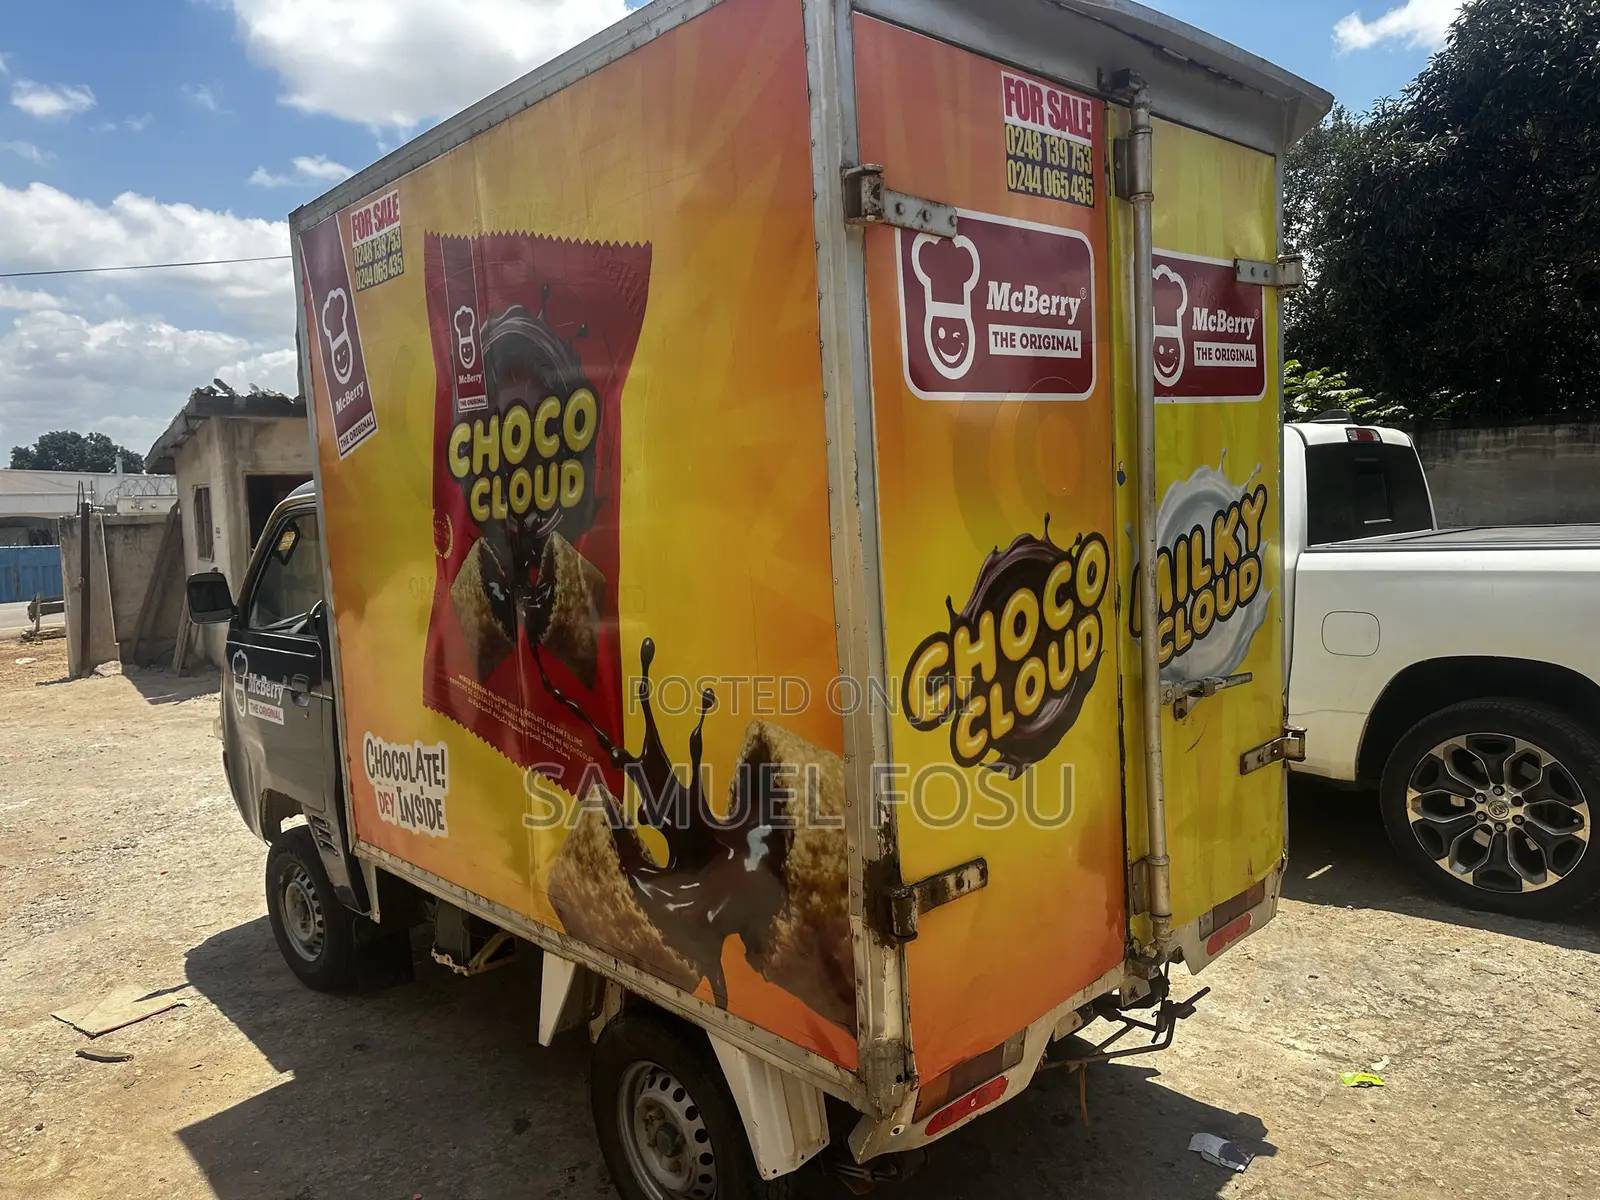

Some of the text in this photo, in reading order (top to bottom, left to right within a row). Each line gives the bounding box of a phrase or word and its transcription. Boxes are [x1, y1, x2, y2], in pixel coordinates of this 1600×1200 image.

[1003, 76, 1092, 140] FOR SALE
[1005, 125, 1092, 175] 0248 139 753
[1007, 159, 1093, 205] 0244 065 435
[352, 192, 400, 242] FOR SALE
[353, 228, 401, 267] 0248 139 753
[356, 252, 403, 290] 0244 065 435
[992, 331, 1078, 351] THE ORIGINAL
[1196, 347, 1254, 362] THE ORIGINAL
[335, 381, 364, 415] McBerry
[458, 374, 482, 384] McBerry
[340, 416, 373, 448] THE ORIGINAL
[448, 387, 597, 479] CHOCO
[469, 458, 585, 522] CLOUD
[904, 536, 1108, 727] CHOCO
[1157, 556, 1261, 665] CLOUD
[952, 611, 1100, 763] CLOUD
[366, 738, 446, 789] CHOCOLATE!
[378, 791, 395, 818] DEY
